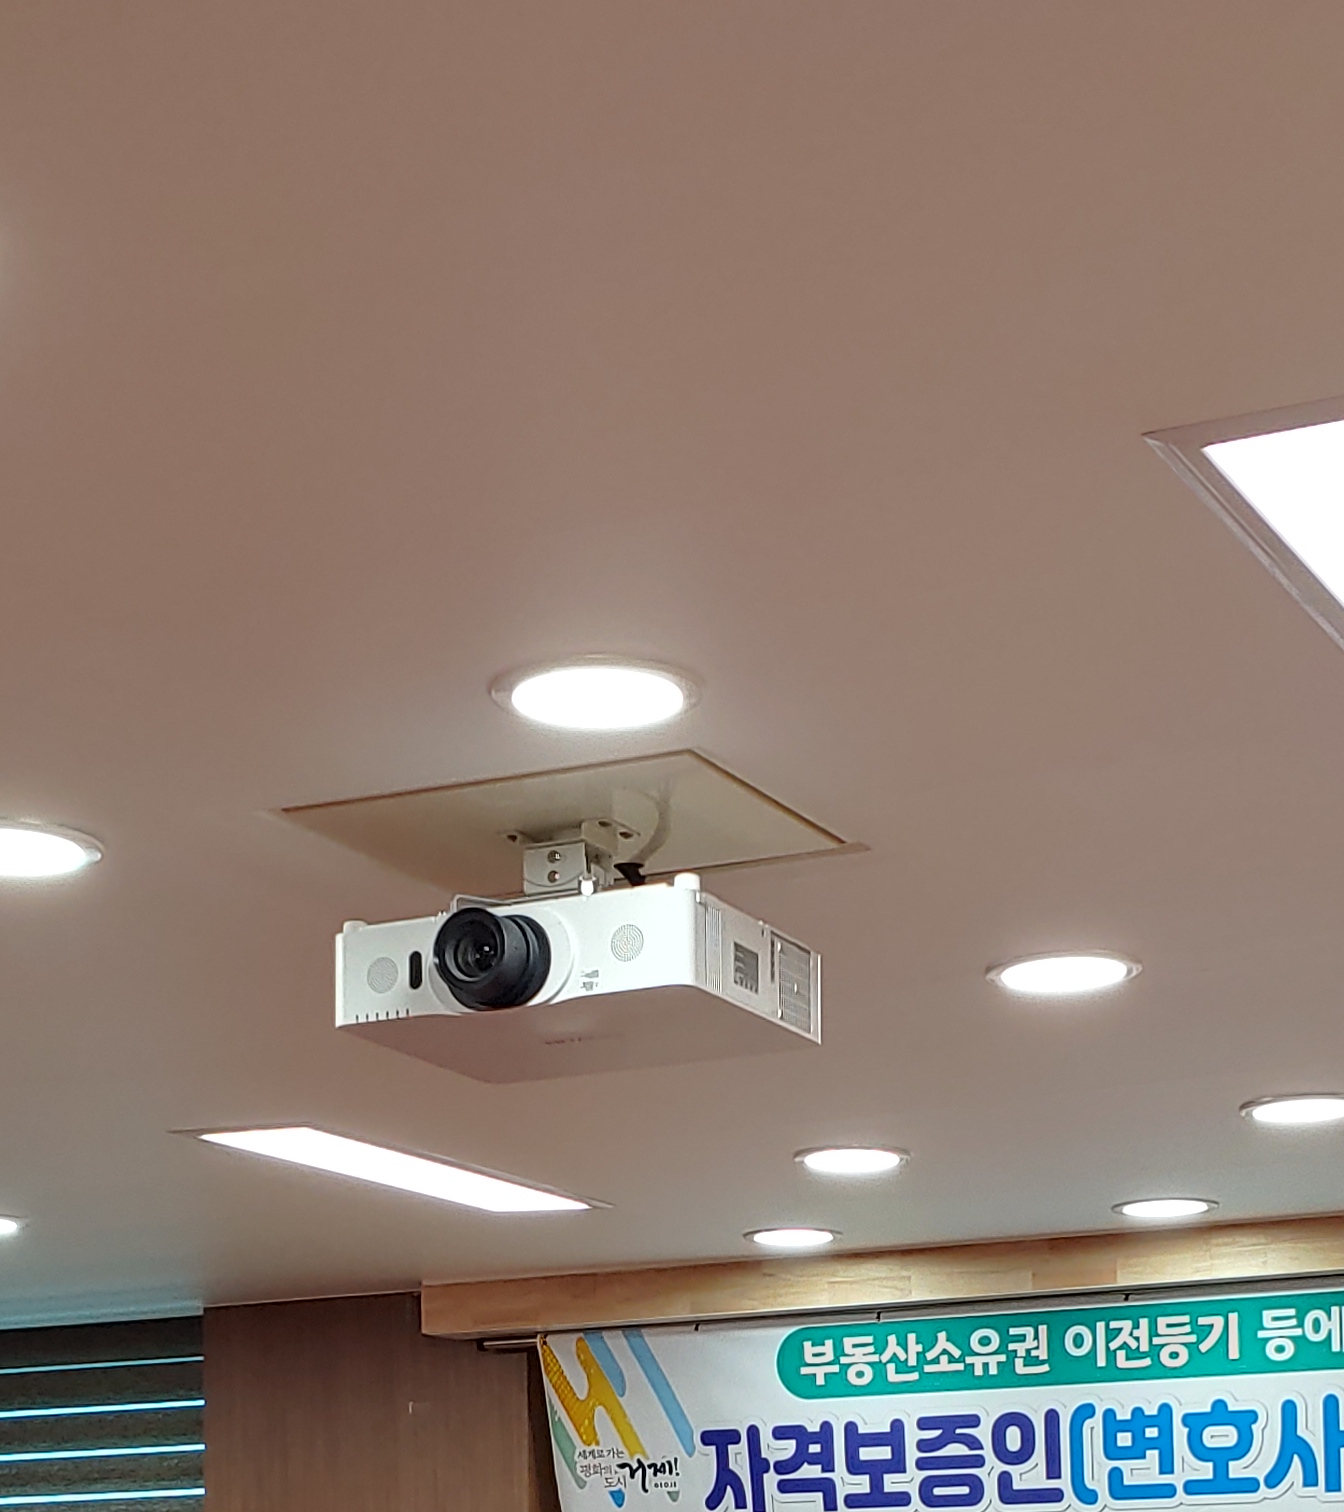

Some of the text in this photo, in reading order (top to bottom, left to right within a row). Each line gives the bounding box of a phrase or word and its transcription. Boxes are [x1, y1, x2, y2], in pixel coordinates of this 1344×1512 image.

[799, 1324, 1051, 1386] 부동산소유권
[1064, 1311, 1241, 1368] 이전등기
[604, 1475, 626, 1489] 도시
